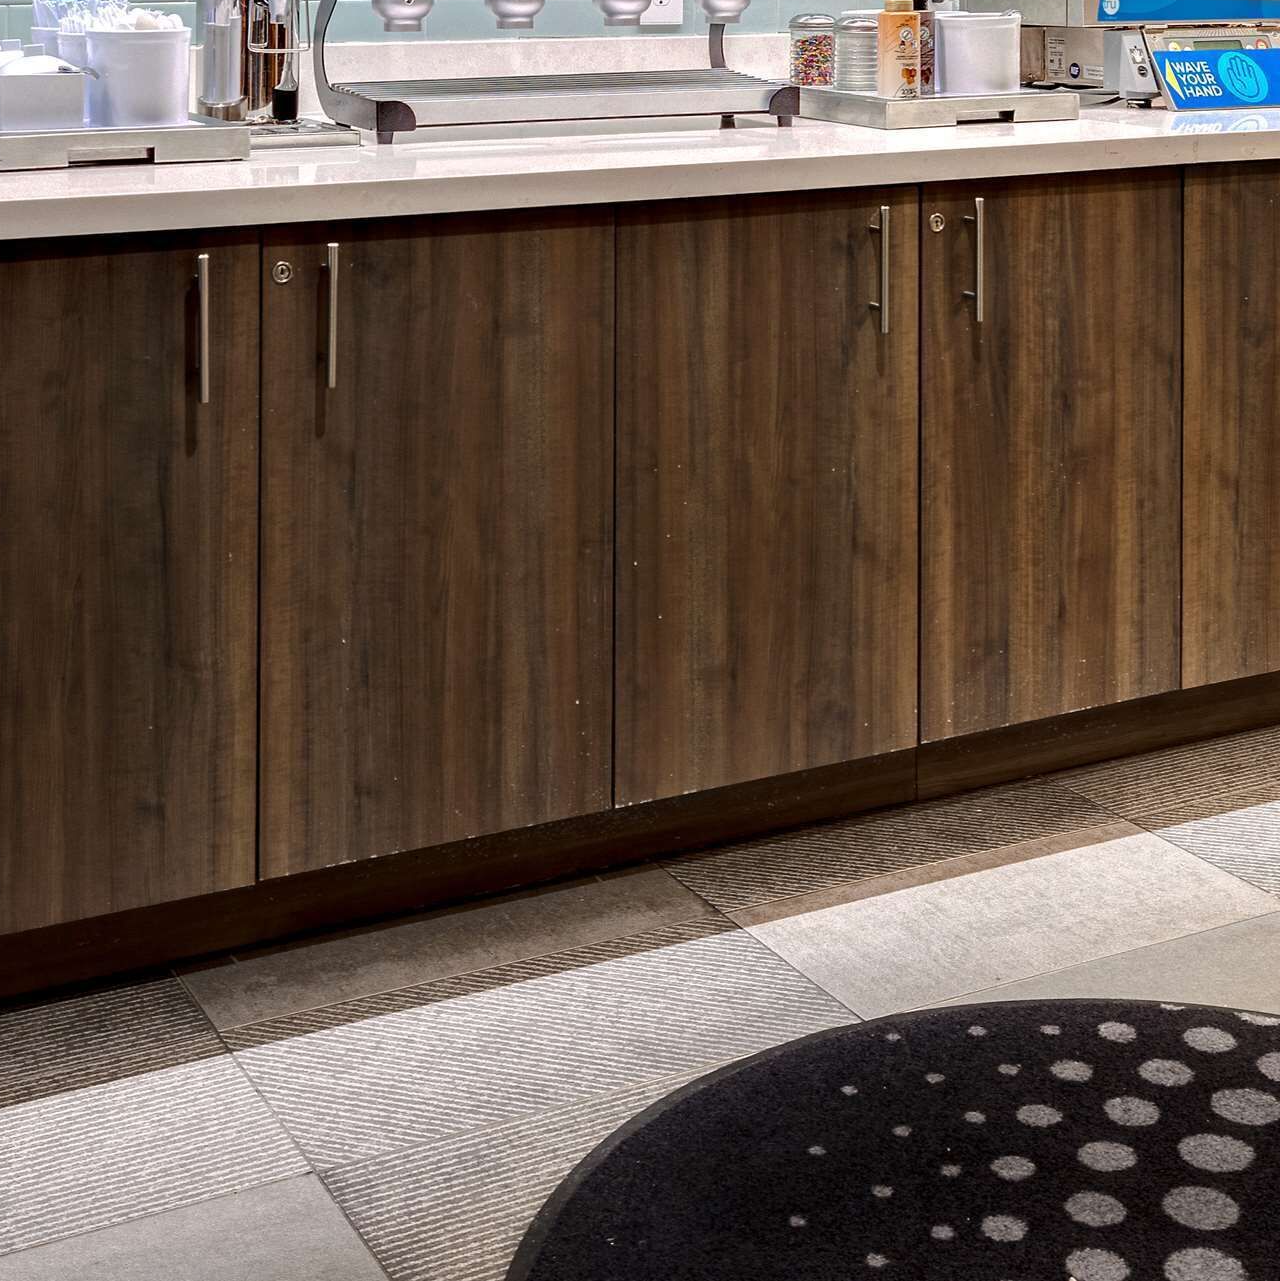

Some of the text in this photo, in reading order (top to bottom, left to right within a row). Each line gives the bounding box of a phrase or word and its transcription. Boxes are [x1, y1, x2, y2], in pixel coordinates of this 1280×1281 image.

[1170, 61, 1211, 74] WAVE
[1177, 73, 1217, 86] YOUR
[1183, 85, 1223, 98] HAND
